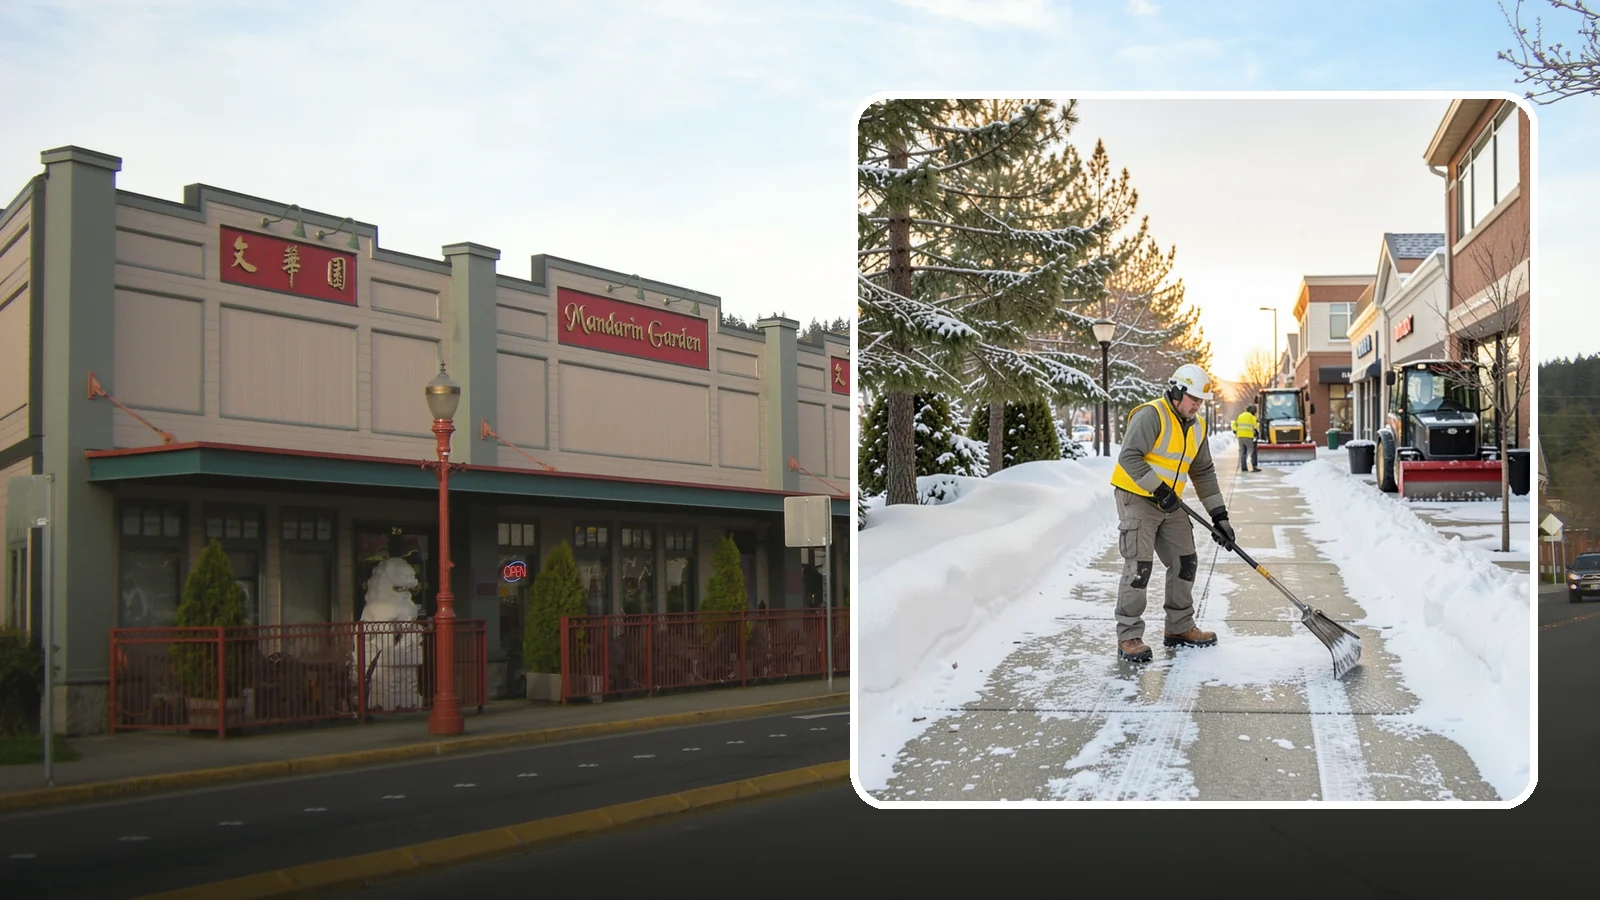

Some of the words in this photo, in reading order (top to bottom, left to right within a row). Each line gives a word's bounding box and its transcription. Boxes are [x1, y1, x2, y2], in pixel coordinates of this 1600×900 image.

[230, 235, 346, 291] 文華園
[564, 302, 644, 341] Mandarin
[647, 320, 702, 352] Garden
[503, 565, 527, 578] OPEN
